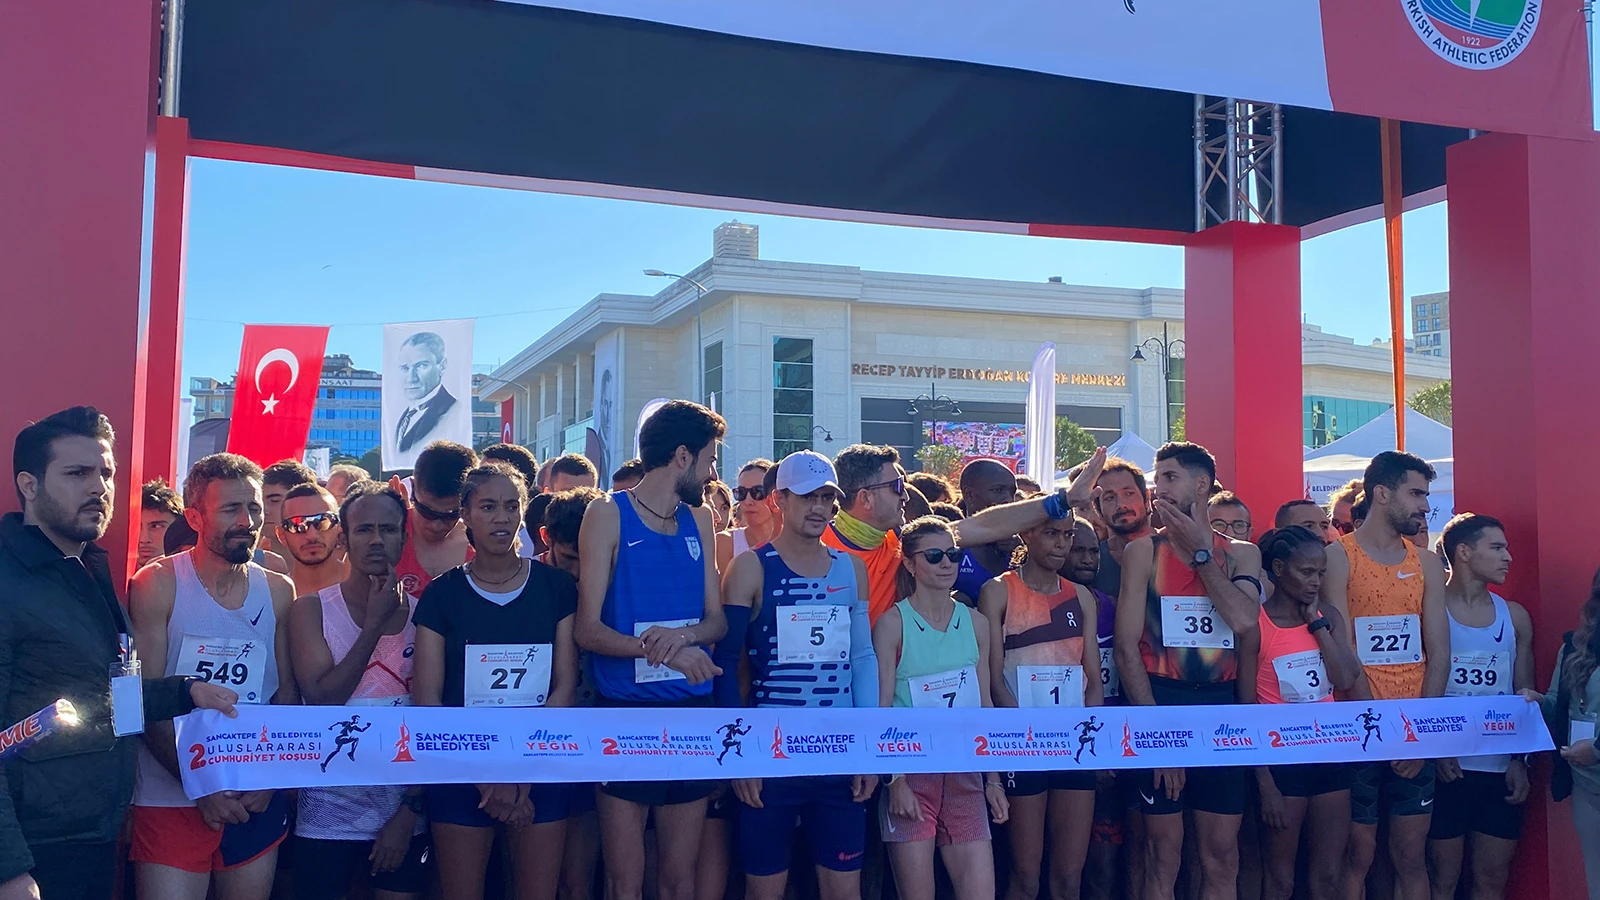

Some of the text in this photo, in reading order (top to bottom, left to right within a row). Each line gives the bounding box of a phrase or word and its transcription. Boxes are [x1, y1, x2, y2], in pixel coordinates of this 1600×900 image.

[1433, 37, 1488, 65] ATHLETIC
[1489, 1, 1539, 63] FEDERATION
[1461, 35, 1481, 47] 1922
[851, 363, 896, 377] RECEP
[899, 365, 947, 379] TAYYİP
[1184, 616, 1213, 634] 38
[810, 626, 825, 646] 5
[1370, 634, 1411, 652] 227
[196, 660, 248, 685] 549
[1306, 669, 1320, 687] 3
[1454, 667, 1497, 686] 339
[490, 668, 527, 690] 27
[942, 691, 957, 708] 7
[1049, 686, 1060, 705] 1
[1413, 715, 1468, 725] SANCAKTEPE
[1484, 709, 1512, 721] Alper
[1214, 723, 1247, 738] Alper
[1416, 723, 1463, 734] BELEDİYESİ
[1483, 720, 1516, 731] YEĞİN
[206, 732, 257, 743] SANCAKTEPE
[415, 732, 499, 743] SANCAKTEPE
[528, 729, 573, 744] Alper
[786, 734, 855, 745] SANCAKTEPE
[880, 727, 918, 742] Alper
[1134, 730, 1194, 740] SANCAKTEPE
[416, 741, 490, 751] BELEDİYESİ
[525, 740, 579, 751] YEĞİN
[619, 742, 714, 751] ULUSLARARASI
[877, 740, 922, 752] YEĞİN
[990, 741, 1071, 749] ULUSLARARASI
[1135, 739, 1188, 749] BELEDİYESİ
[1212, 735, 1253, 747] YEĞİN
[207, 742, 321, 755] ULUSLARARASI
[787, 743, 848, 754] BELEDİYESİ
[1043, 749, 1072, 757] KOŞUSU
[208, 752, 321, 765] CUMHURİYET KOŞUSU
